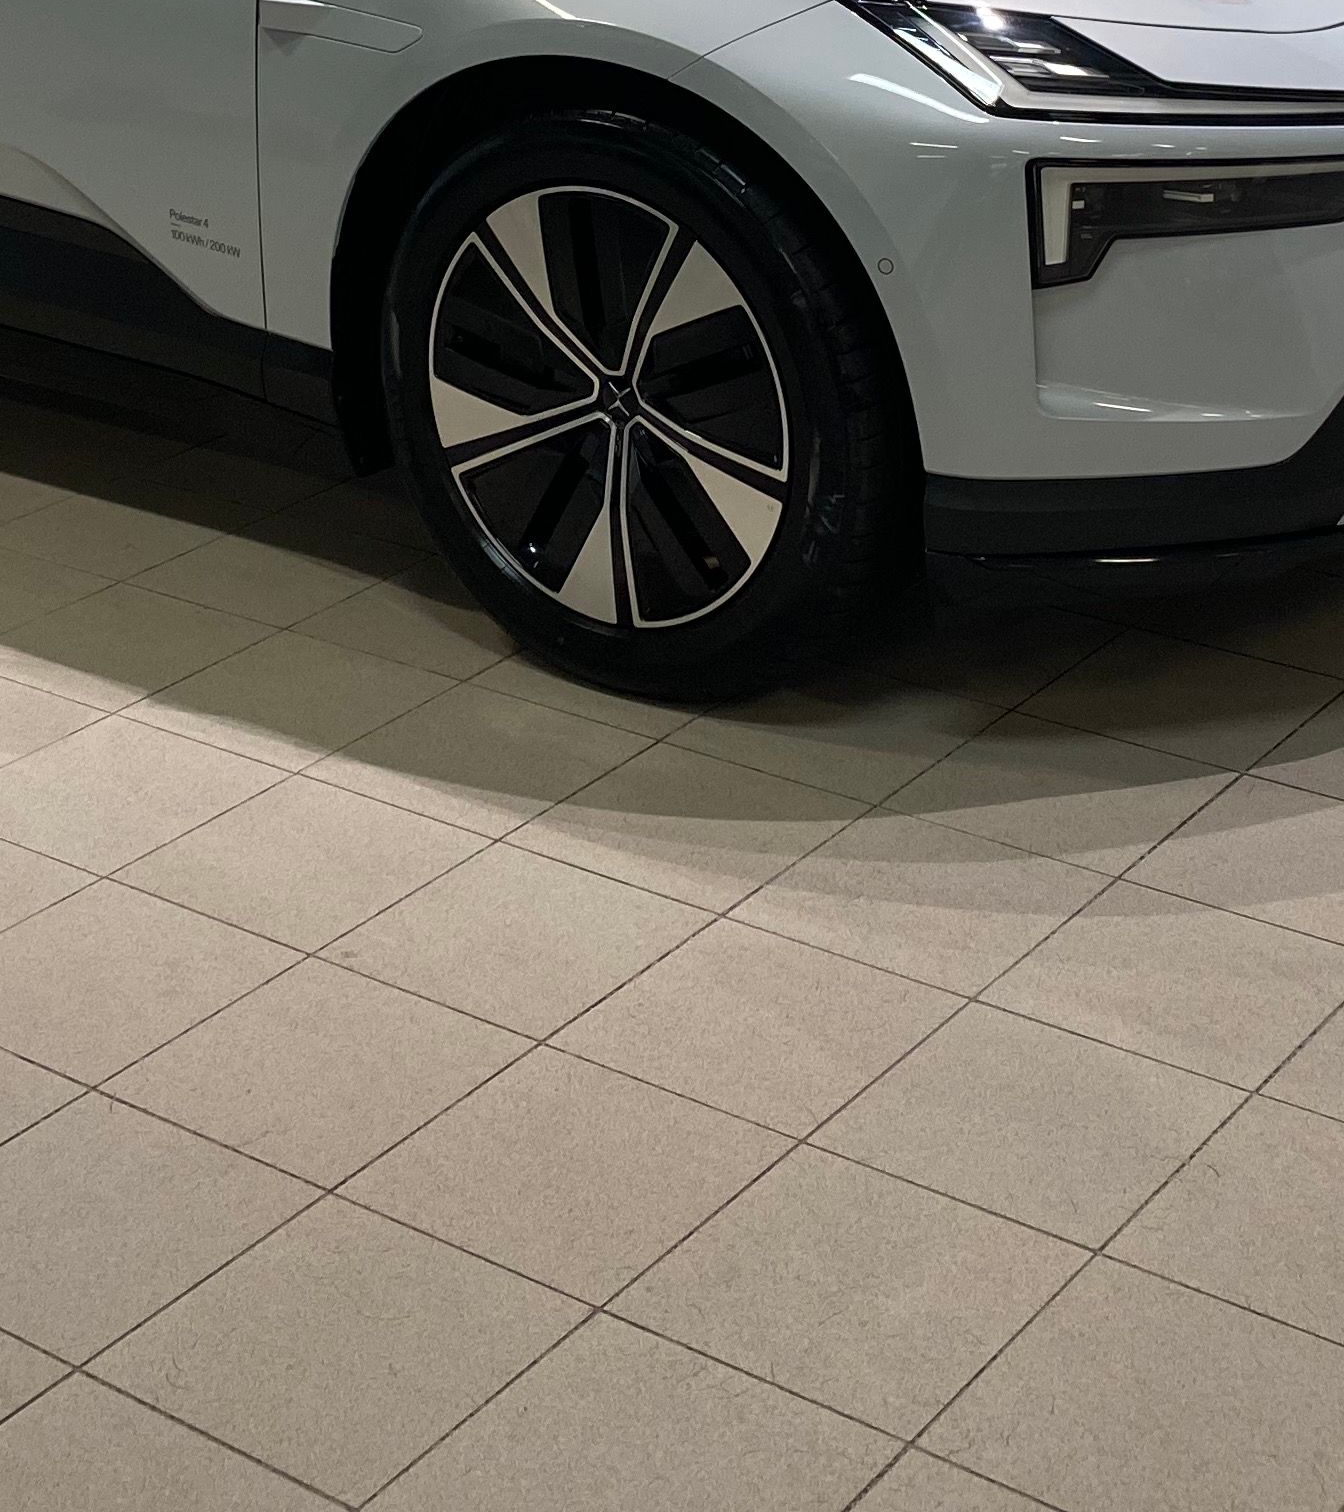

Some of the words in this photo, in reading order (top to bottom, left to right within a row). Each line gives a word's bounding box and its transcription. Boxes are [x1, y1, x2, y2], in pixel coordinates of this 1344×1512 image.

[168, 208, 203, 227] Polestar
[202, 218, 210, 229] 4
[170, 229, 185, 242] 100
[185, 232, 205, 248] kWh
[209, 239, 227, 254] 200
[226, 244, 241, 259] kW
